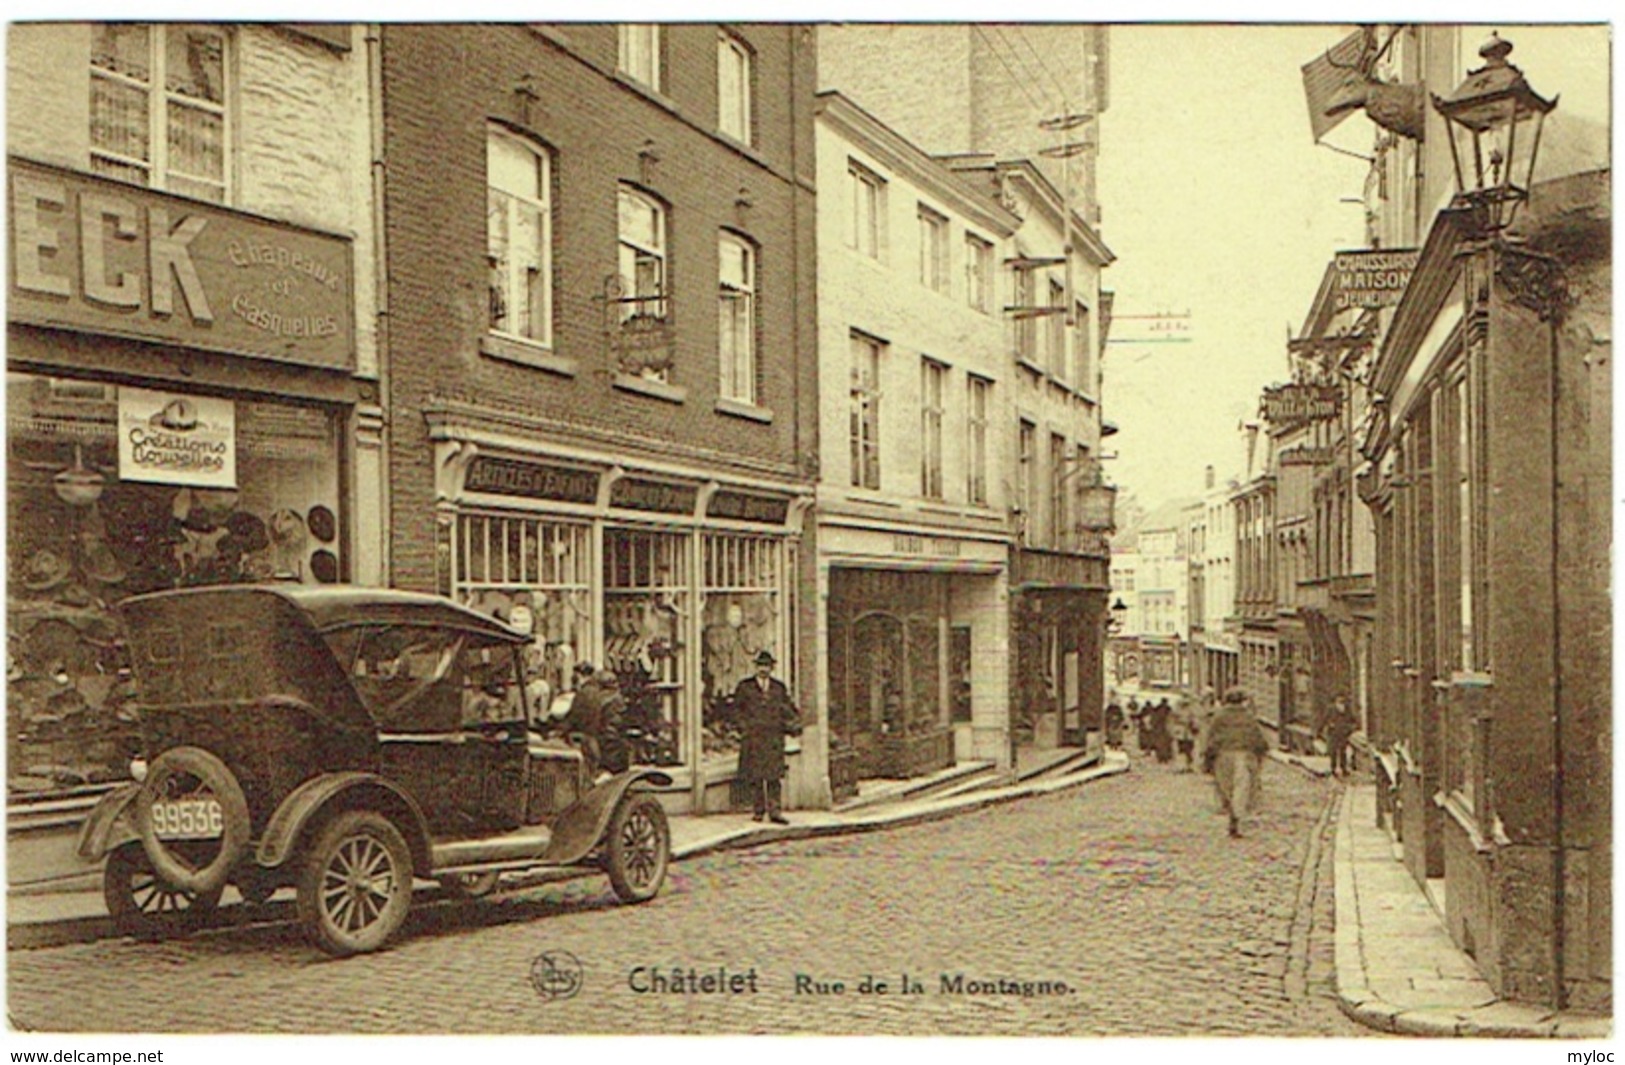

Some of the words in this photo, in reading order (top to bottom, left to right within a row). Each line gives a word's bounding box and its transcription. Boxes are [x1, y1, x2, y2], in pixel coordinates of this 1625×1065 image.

[12, 173, 214, 326] ECK
[228, 241, 339, 290] Chapeaux
[1340, 271, 1411, 289] MAISON
